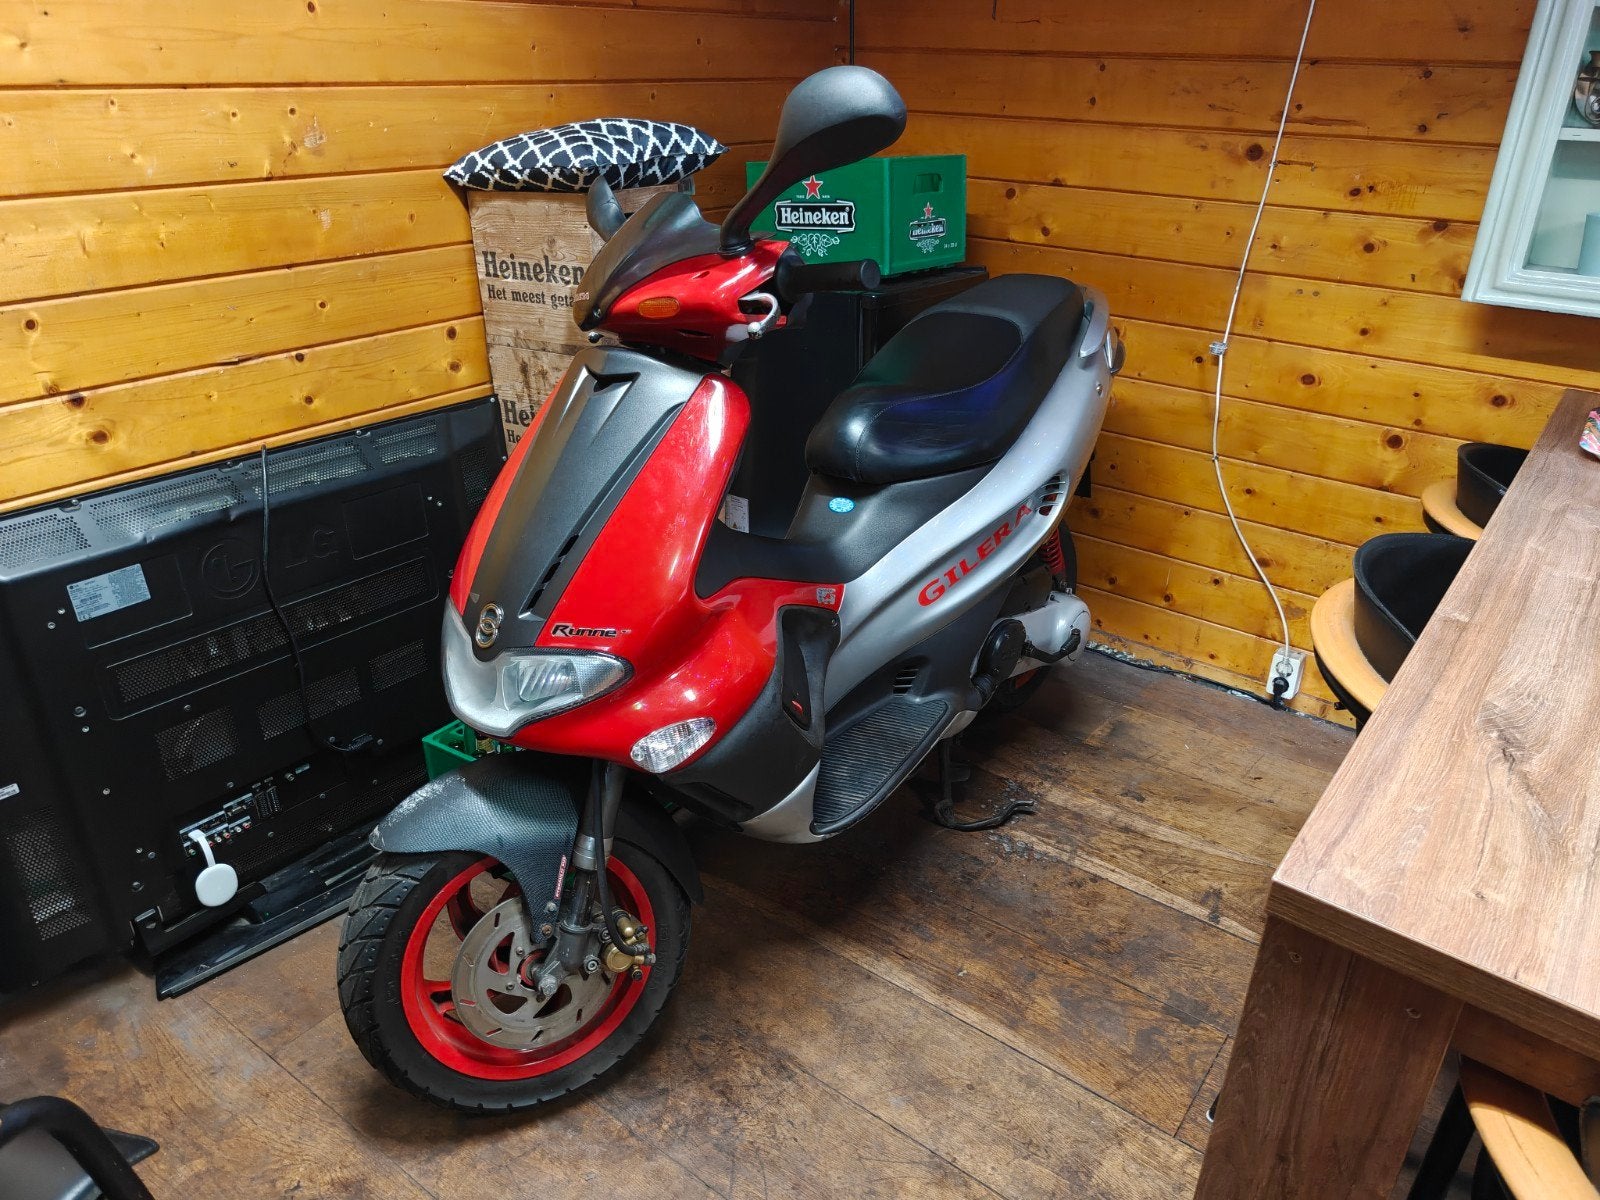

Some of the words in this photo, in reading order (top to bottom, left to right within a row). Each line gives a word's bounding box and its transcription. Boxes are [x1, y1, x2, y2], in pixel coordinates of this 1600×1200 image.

[781, 207, 850, 225] Heineken
[487, 284, 507, 300] Het
[511, 290, 546, 304] meest
[917, 502, 1032, 607] GILERA
[551, 623, 632, 638] Runne
